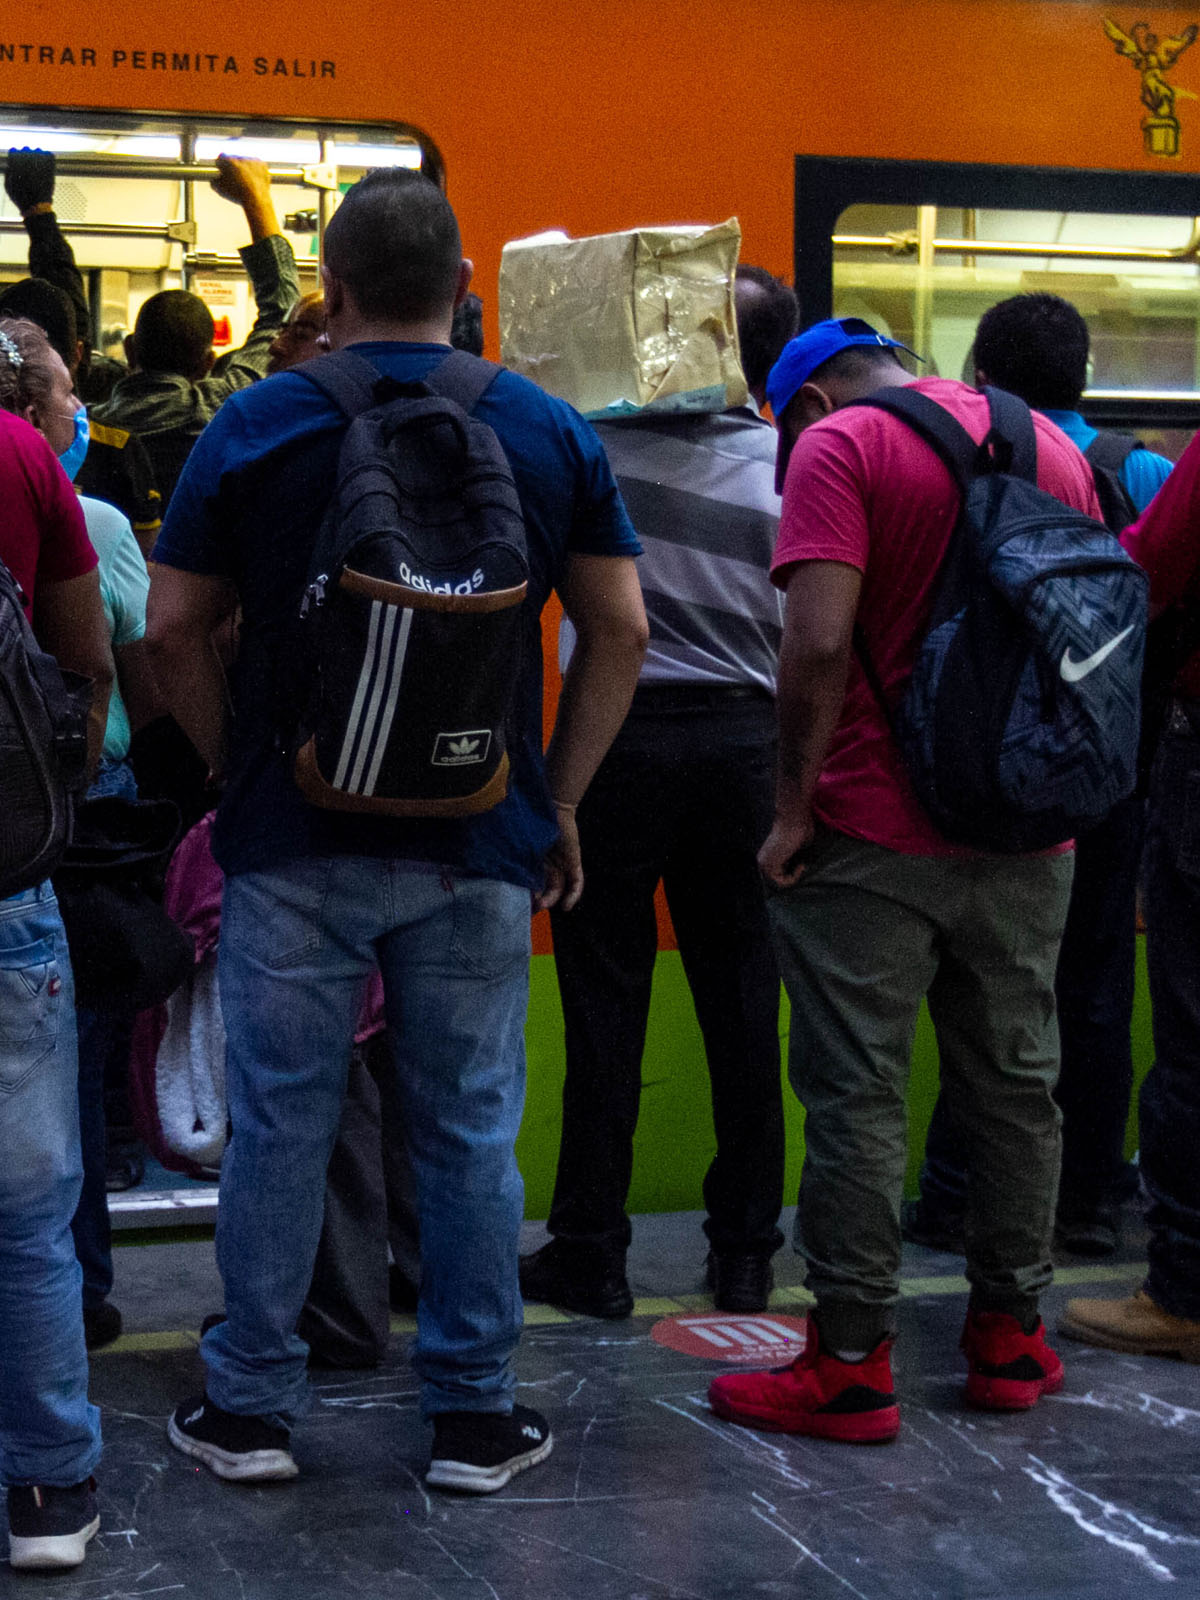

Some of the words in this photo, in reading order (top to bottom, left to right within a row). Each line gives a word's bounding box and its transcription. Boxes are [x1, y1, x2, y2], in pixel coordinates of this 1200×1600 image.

[112, 50, 239, 73] PERMITA
[254, 57, 336, 78] SALIR
[400, 562, 484, 595] adidas
